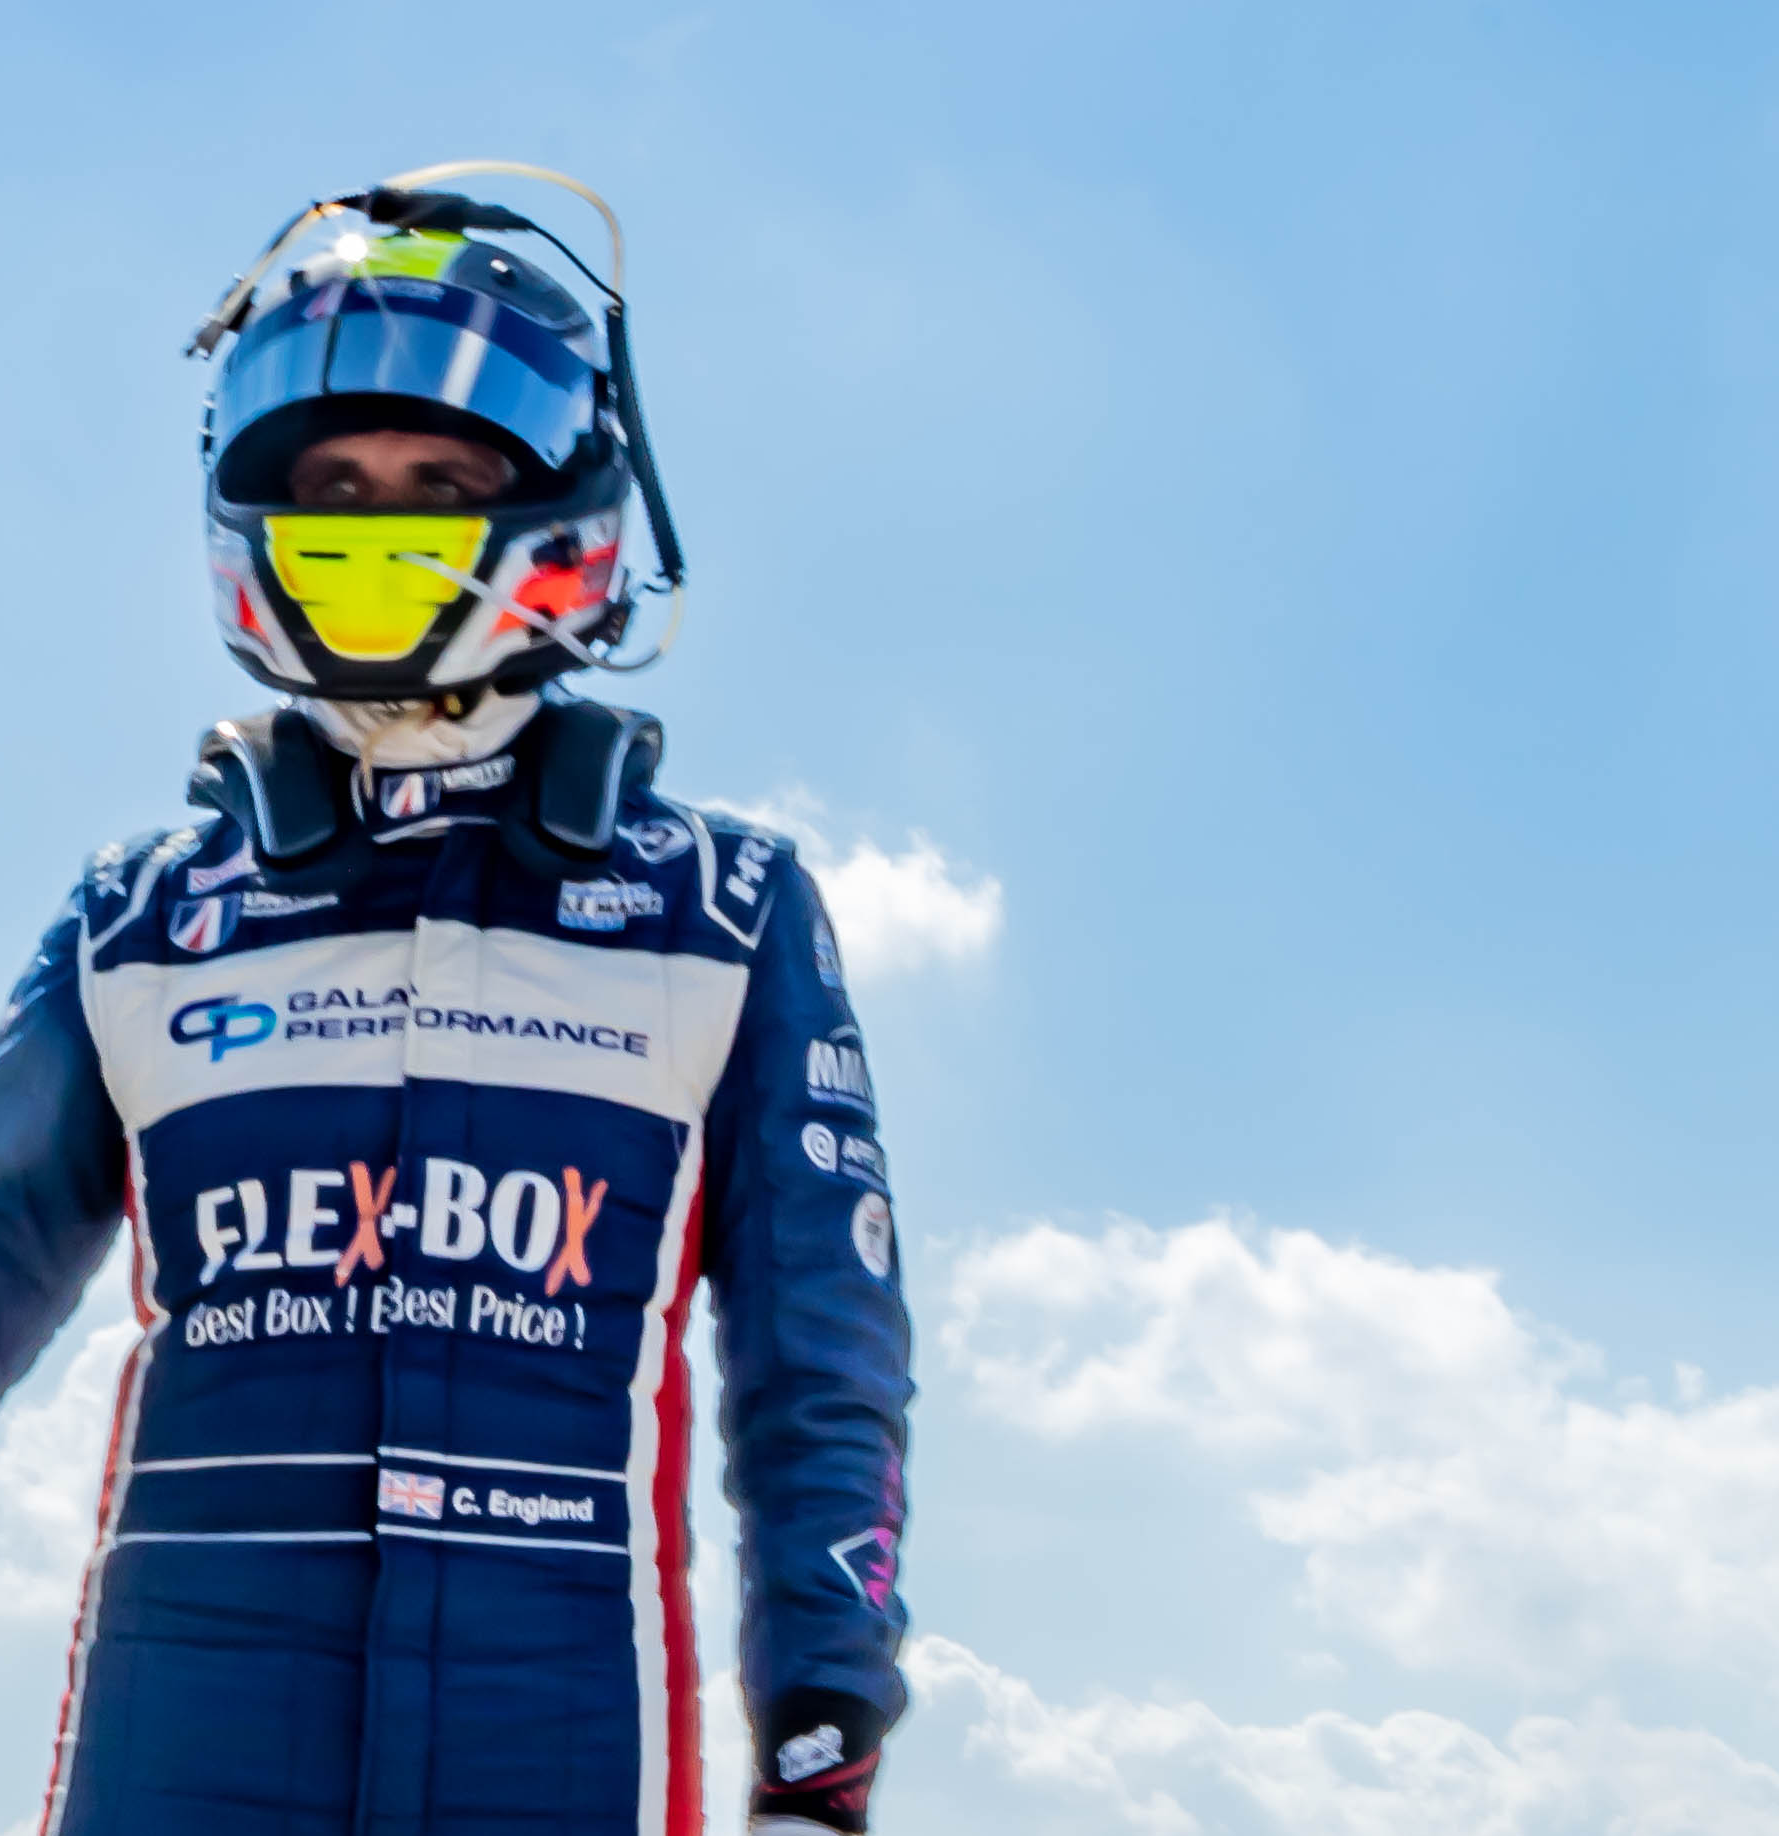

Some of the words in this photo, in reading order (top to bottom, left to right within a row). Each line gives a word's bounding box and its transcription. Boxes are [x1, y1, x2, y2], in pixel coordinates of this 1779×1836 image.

[287, 980, 419, 1013] GALA
[284, 1006, 650, 1058] PERFORMANCE
[196, 1156, 609, 1297] FLEX-BOX
[265, 1288, 332, 1338] Box
[469, 1284, 568, 1347] Price
[451, 1486, 482, 1516] C.
[487, 1488, 595, 1526] England
